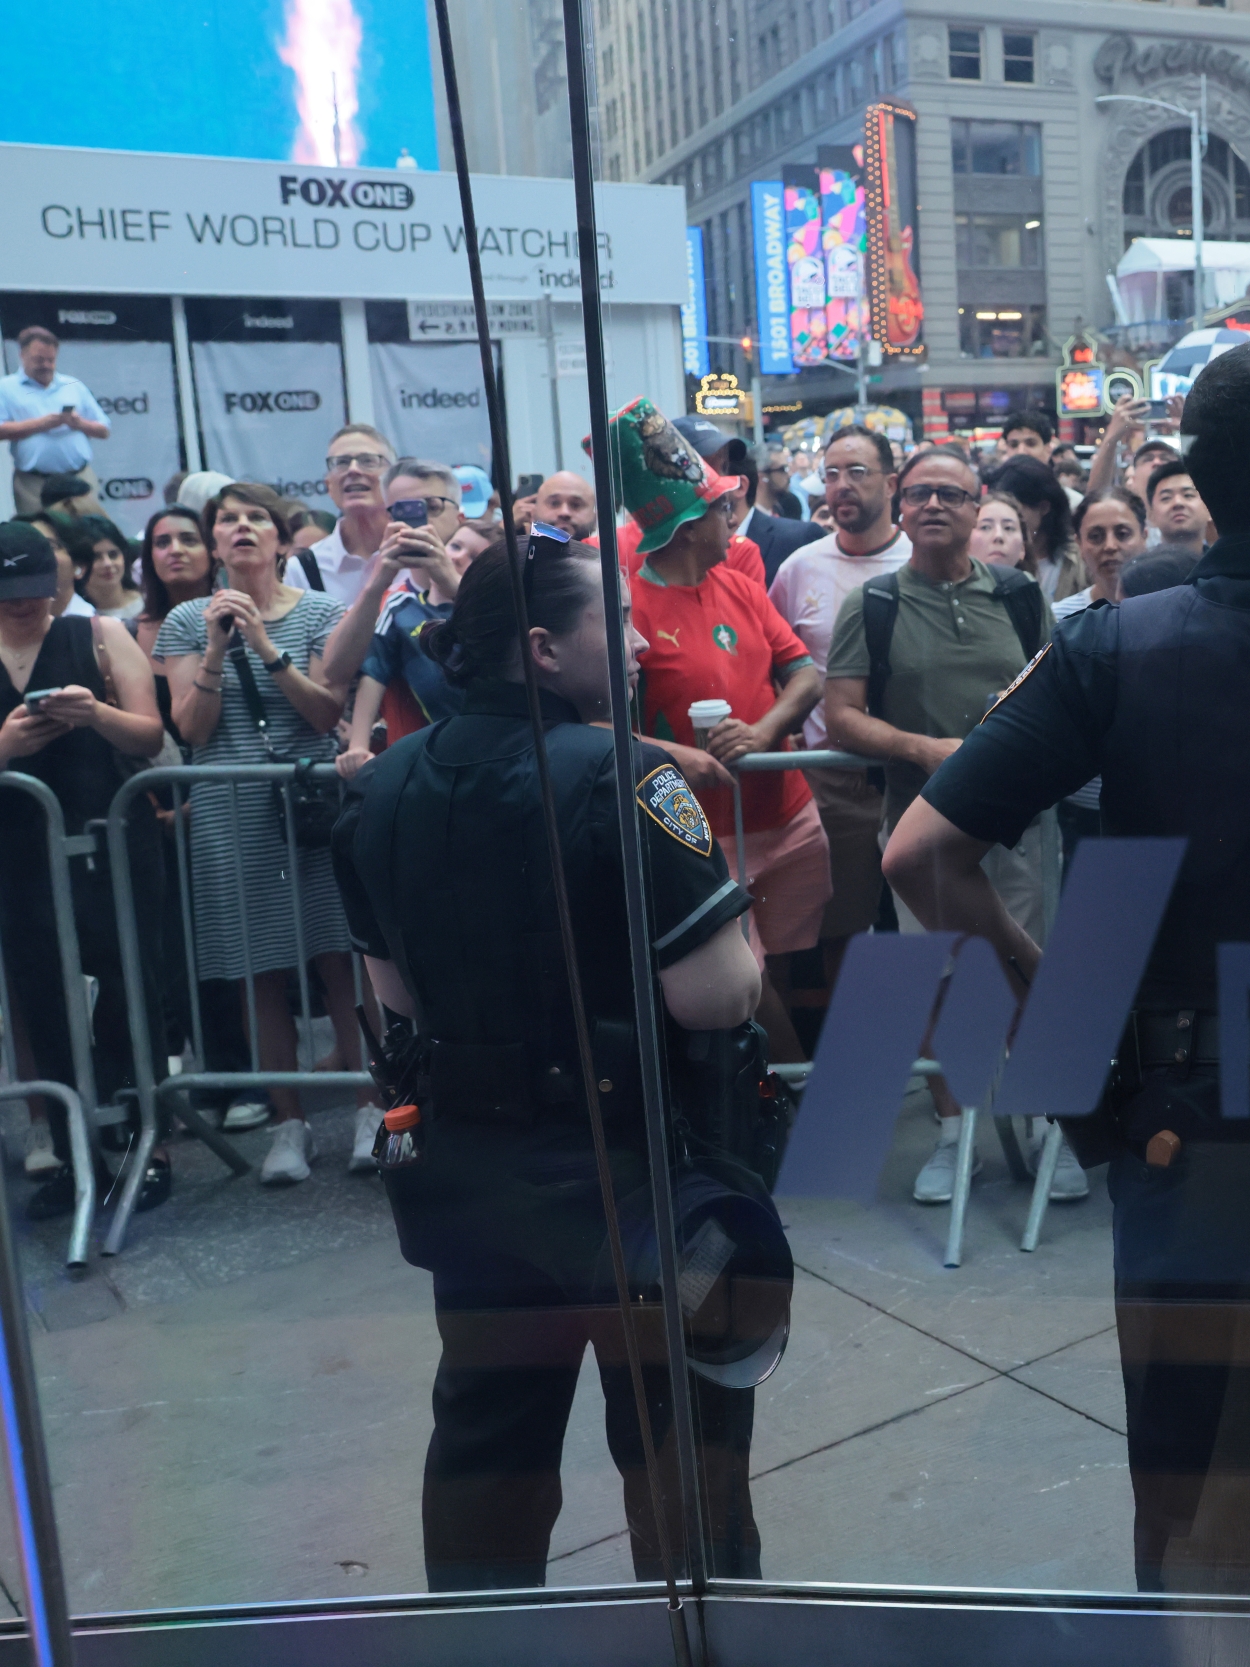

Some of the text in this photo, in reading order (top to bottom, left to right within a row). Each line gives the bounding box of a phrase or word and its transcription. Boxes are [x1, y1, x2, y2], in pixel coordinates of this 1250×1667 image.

[279, 175, 409, 208] FOX ONE
[41, 204, 613, 261] CHIEF WORLD CUP WATCHR
[538, 268, 614, 290] inded
[763, 193, 788, 361] 1501 BROADWAY
[97, 391, 149, 416] eed
[224, 391, 274, 414] FOX
[401, 388, 480, 409] indeed
[652, 770, 677, 790] POLICE
[663, 816, 684, 836] CITY
[685, 833, 698, 844] OF
